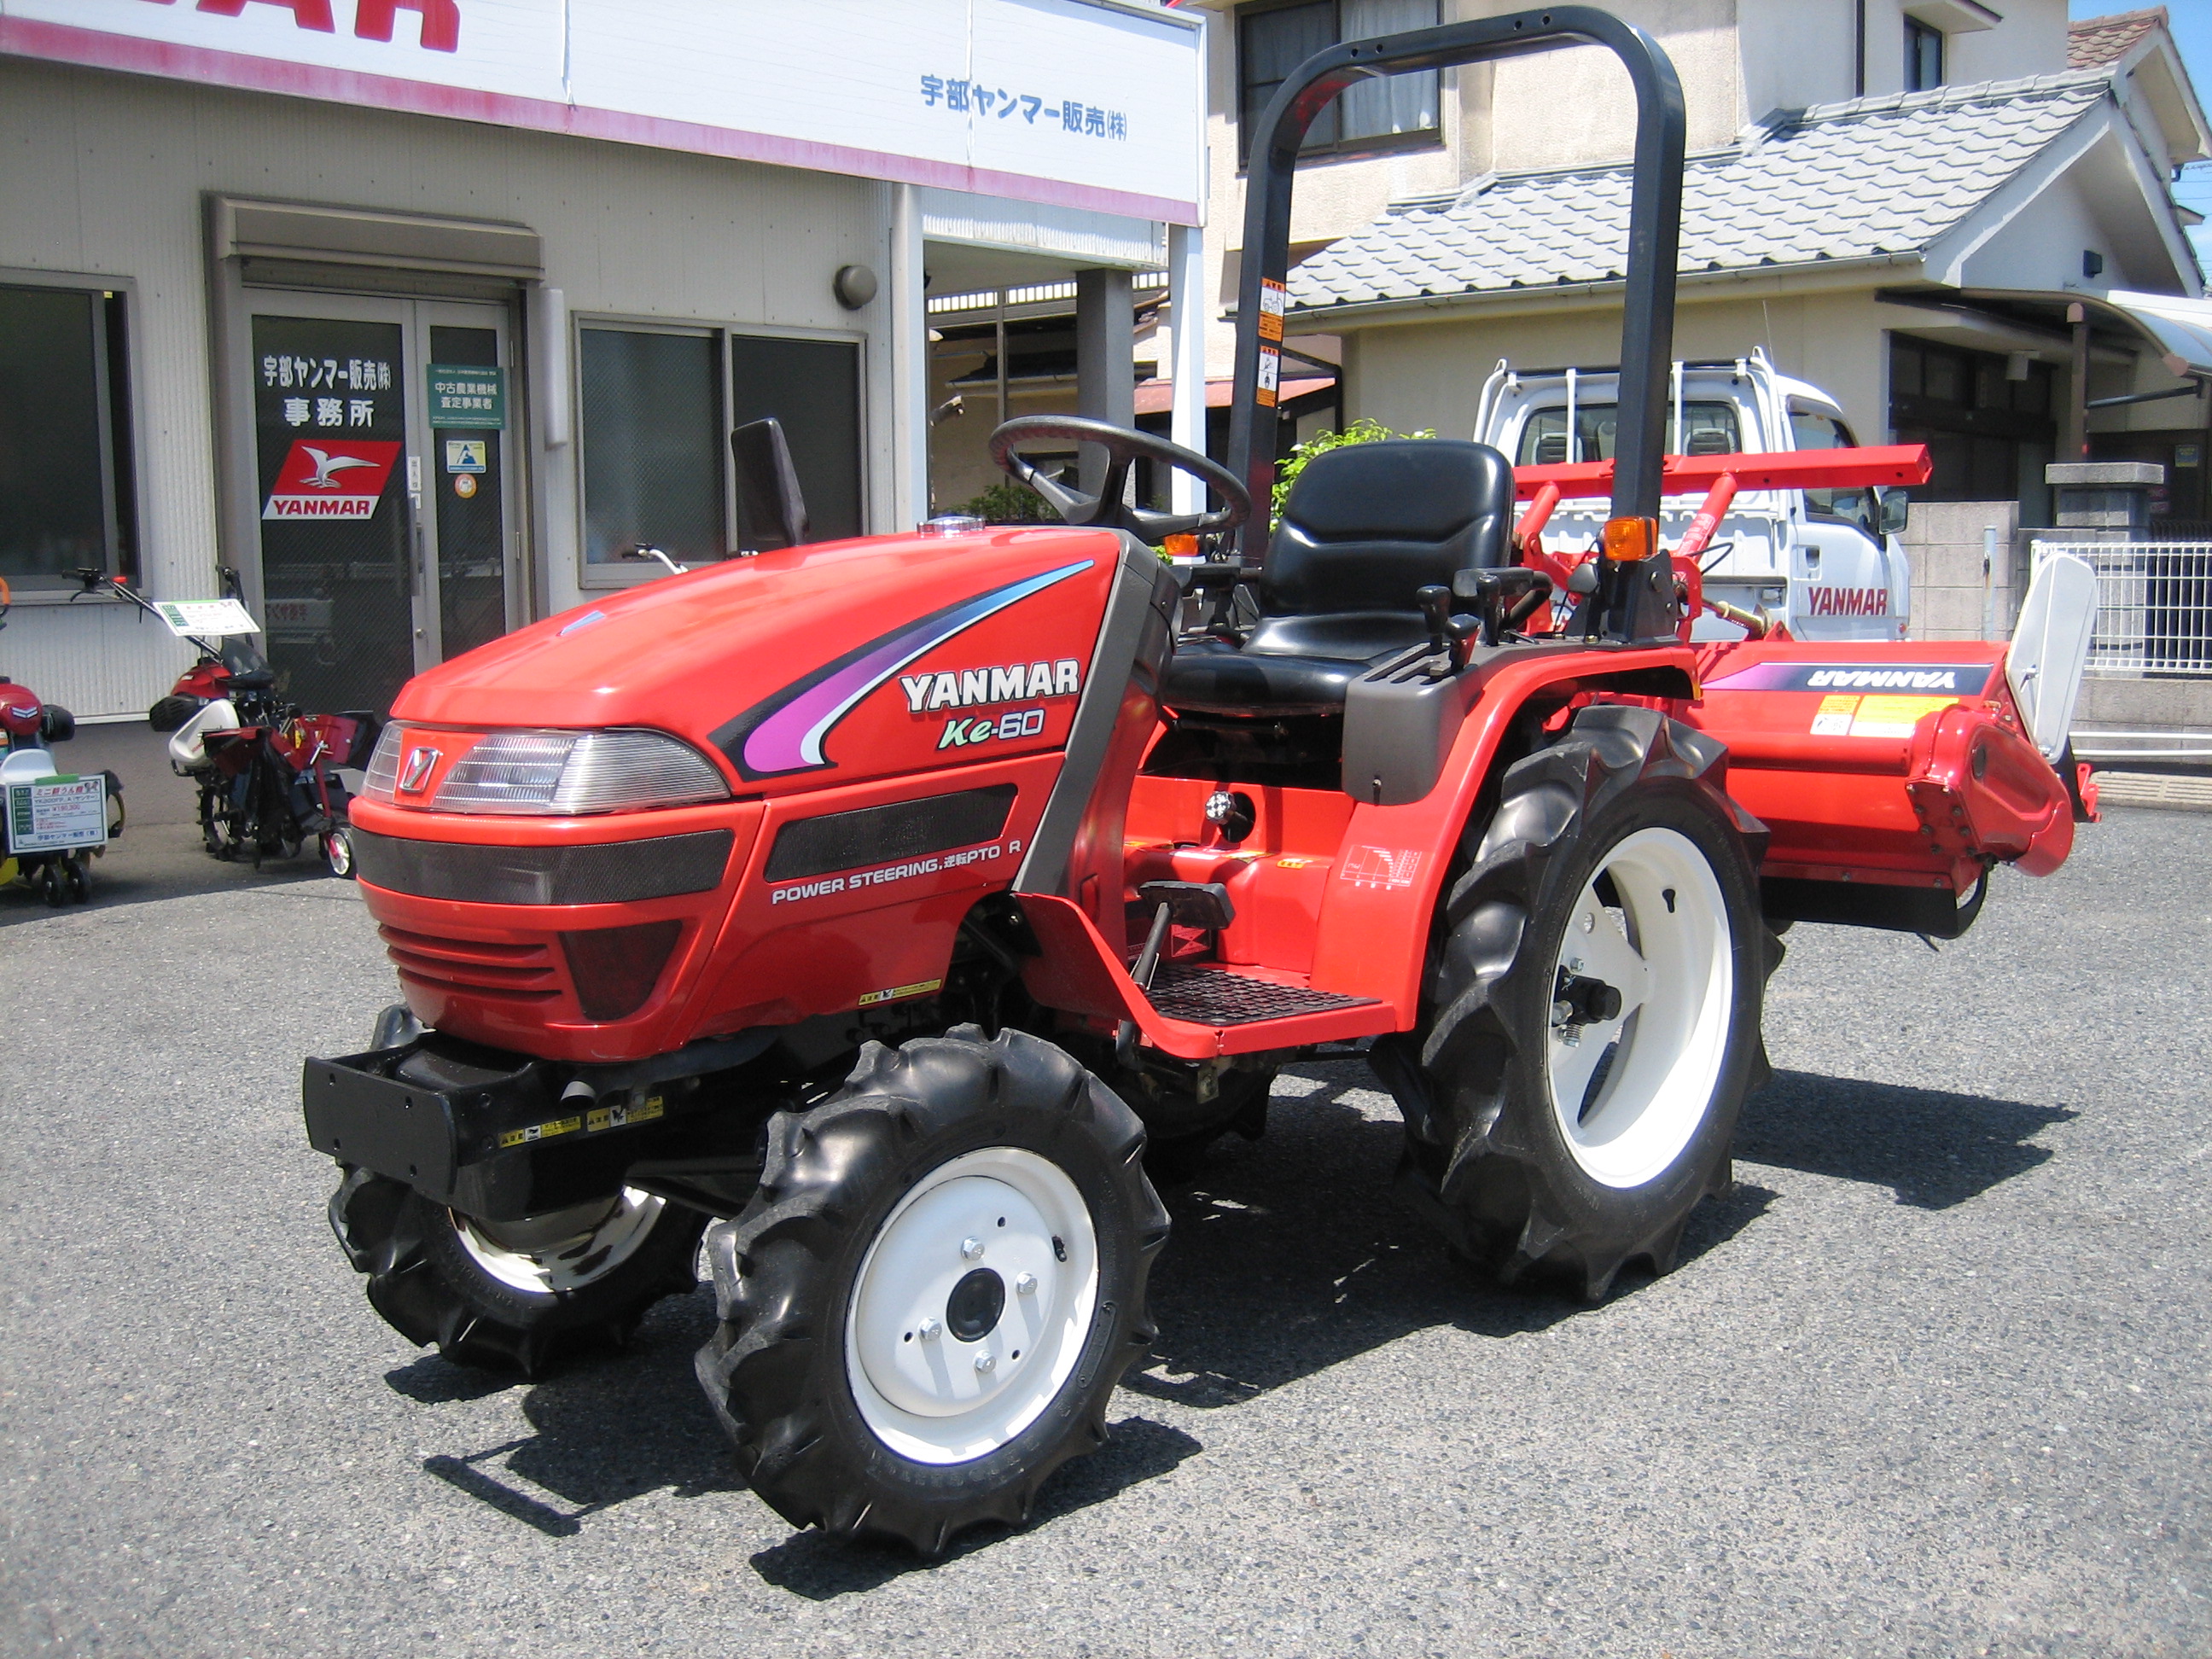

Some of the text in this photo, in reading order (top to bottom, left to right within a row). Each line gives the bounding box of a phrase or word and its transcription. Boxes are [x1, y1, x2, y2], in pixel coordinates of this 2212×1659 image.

[283, 397, 375, 428] 事務所
[273, 500, 370, 515] YANMAR
[1808, 586, 1888, 615] YANMAR
[899, 658, 1080, 713] YANMAR
[1807, 670, 1956, 689] YANMAR
[771, 876, 847, 905] POWER
[1008, 840, 1022, 854] R
